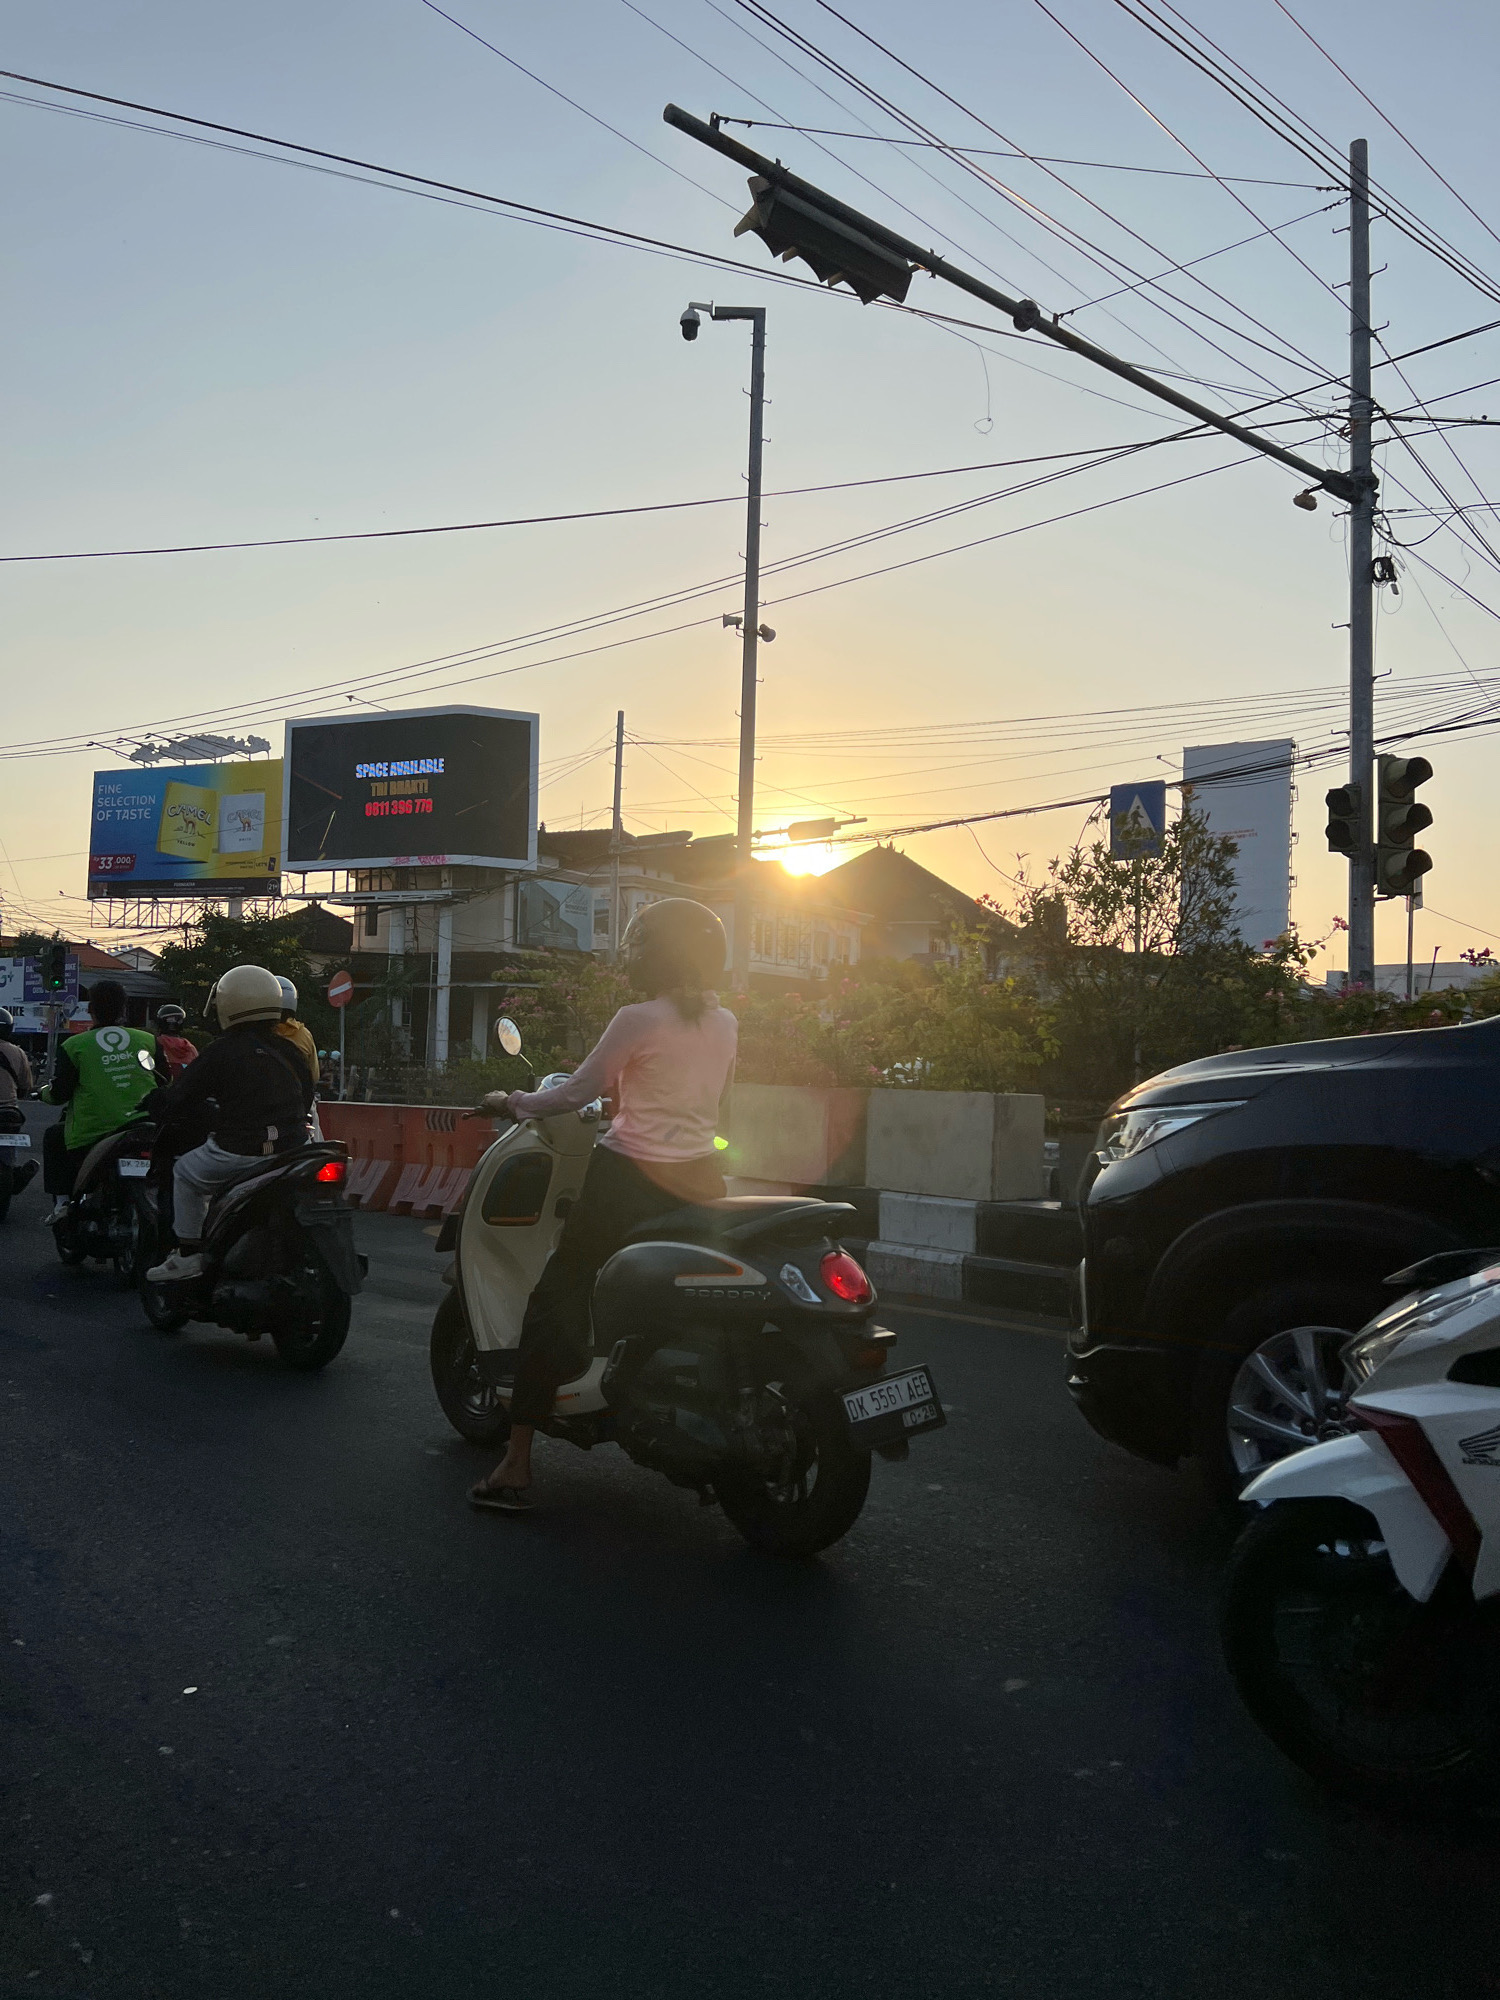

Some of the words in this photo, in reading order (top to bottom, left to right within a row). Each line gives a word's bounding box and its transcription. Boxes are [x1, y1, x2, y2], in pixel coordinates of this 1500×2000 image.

[355, 762, 389, 779] SPACE
[389, 758, 445, 777] AVAILABLE
[98, 784, 122, 795] FINE
[97, 795, 156, 807] SELECTION
[96, 808, 112, 821] OF
[115, 807, 151, 820] TASTE
[167, 804, 212, 826] CAMEL
[226, 809, 263, 823] CAMEL
[176, 839, 196, 848] YELLOW
[101, 1050, 134, 1065] gojek
[683, 1288, 771, 1300] SCOOPY
[846, 1400, 870, 1421] DK
[870, 1386, 905, 1413] 5561
[906, 1373, 930, 1405] AEE
